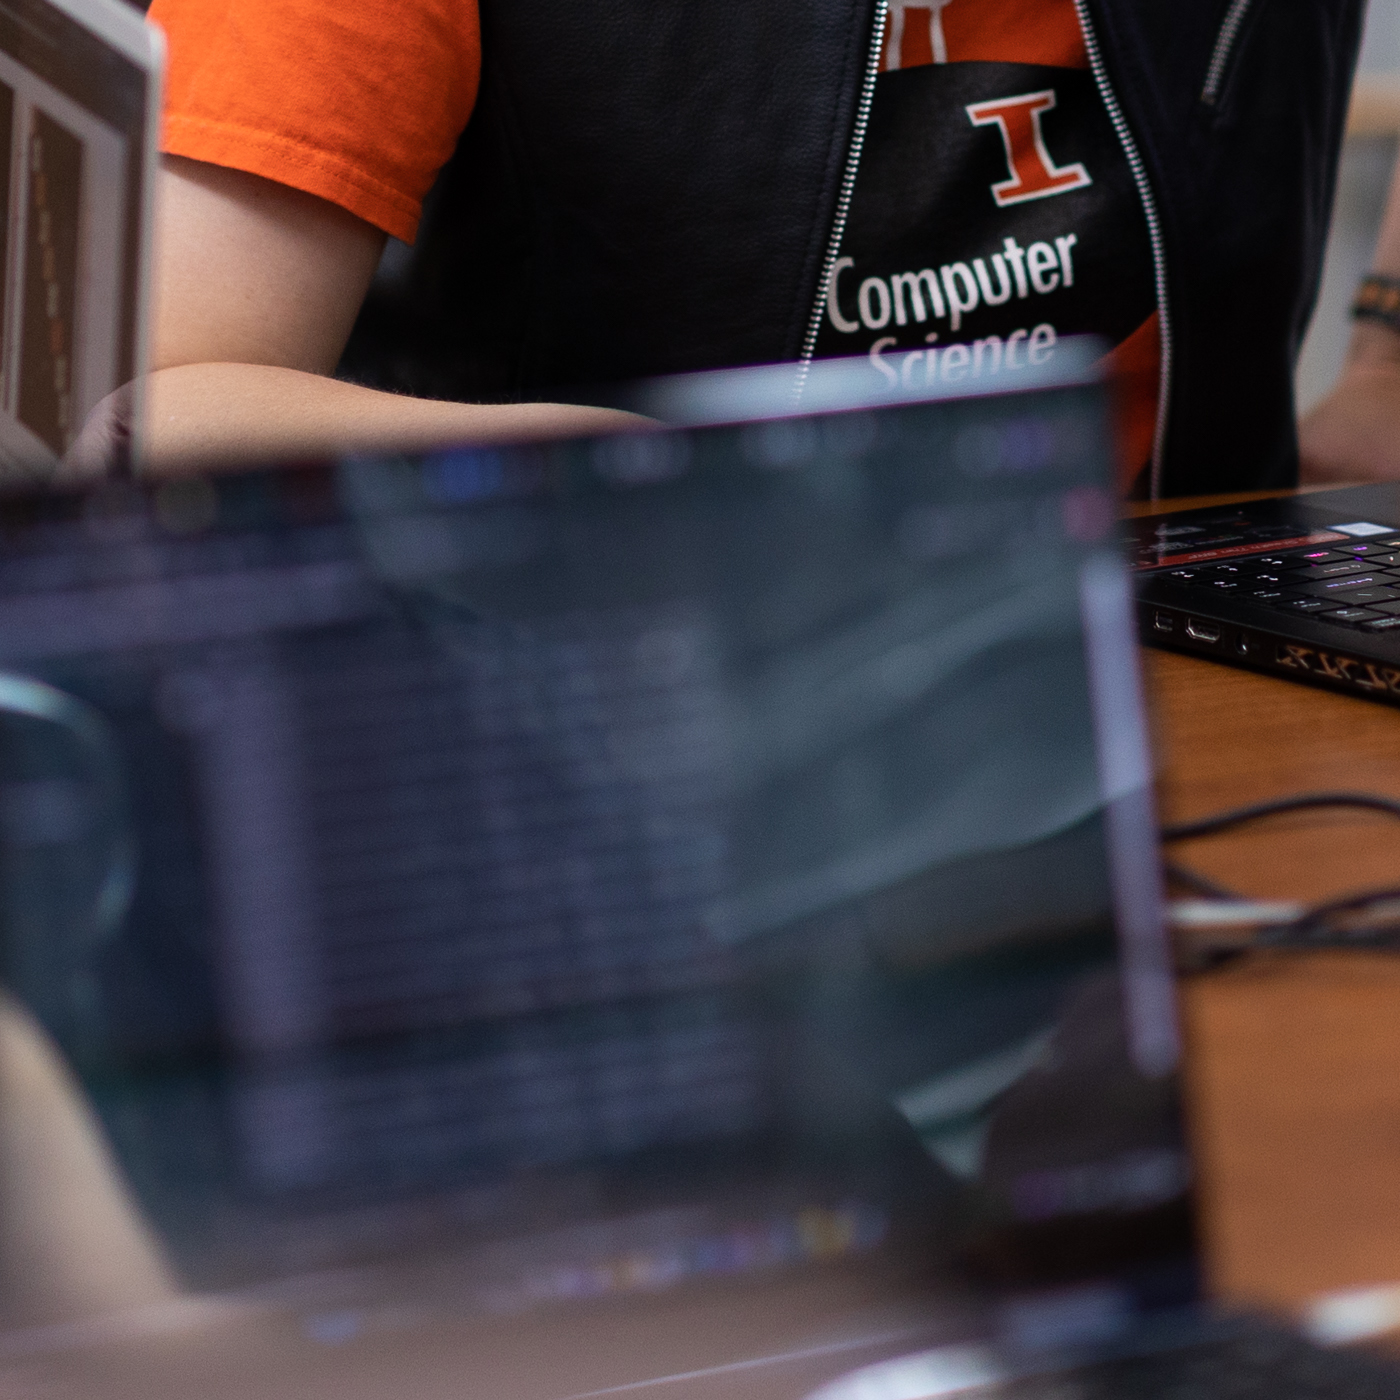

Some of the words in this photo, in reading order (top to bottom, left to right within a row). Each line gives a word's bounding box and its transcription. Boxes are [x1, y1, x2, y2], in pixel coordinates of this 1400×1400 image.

[966, 90, 1092, 207] I
[826, 234, 1078, 332] Computer
[869, 323, 1057, 391] Science
